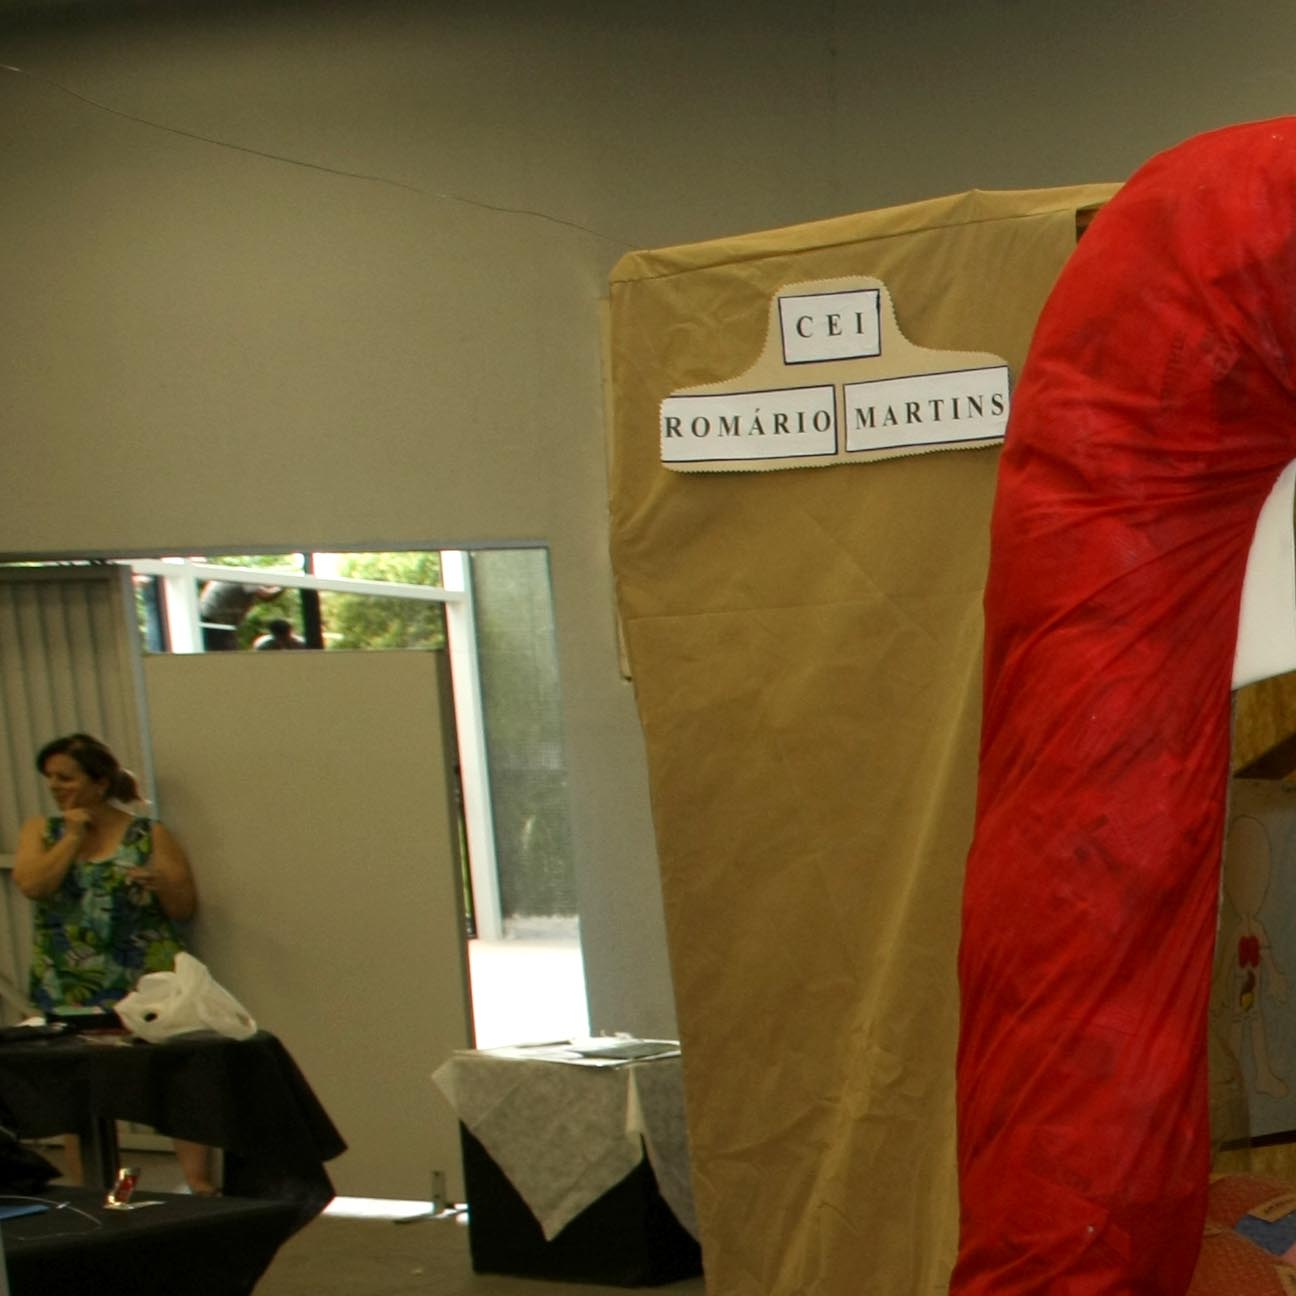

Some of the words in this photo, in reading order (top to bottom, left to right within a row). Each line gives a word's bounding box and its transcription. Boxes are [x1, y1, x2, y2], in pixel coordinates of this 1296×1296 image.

[796, 312, 864, 338] CEI
[665, 409, 831, 438] ROMÁRIO
[855, 393, 1004, 430] MARTINS
